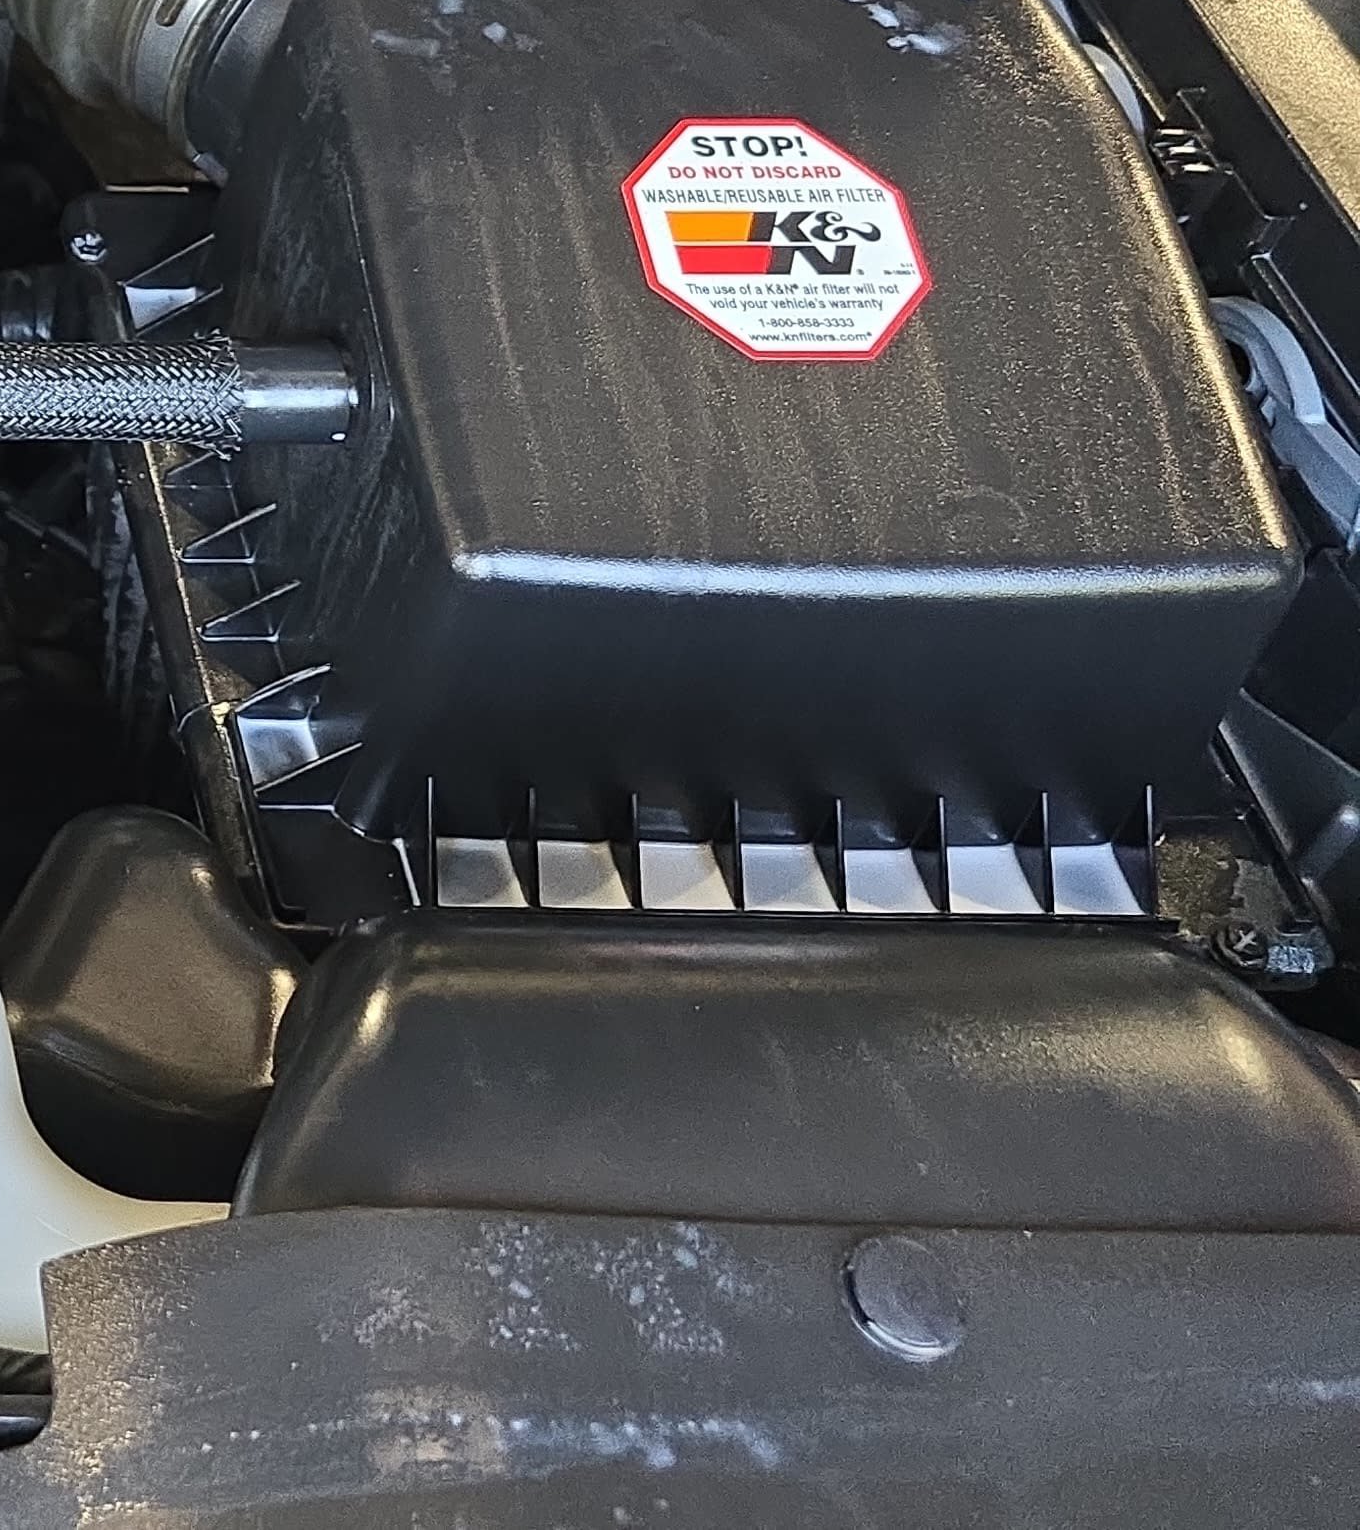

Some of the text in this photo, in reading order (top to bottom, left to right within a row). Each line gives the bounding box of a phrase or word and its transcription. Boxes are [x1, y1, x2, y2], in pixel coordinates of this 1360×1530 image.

[691, 136, 808, 158] STOP!
[667, 166, 842, 180] DO NOT DISCARD
[641, 188, 887, 205] WASHABLE/REUSABLE AIR FILTER
[685, 282, 710, 296] The
[712, 284, 737, 296] use
[740, 282, 754, 296] of
[755, 285, 763, 296] a
[803, 283, 820, 296] air
[822, 283, 852, 296] filter
[855, 283, 876, 296] will
[879, 283, 901, 296] not
[709, 297, 885, 313] void your vehicle's warranty
[757, 317, 856, 329] 1-800-858-3333
